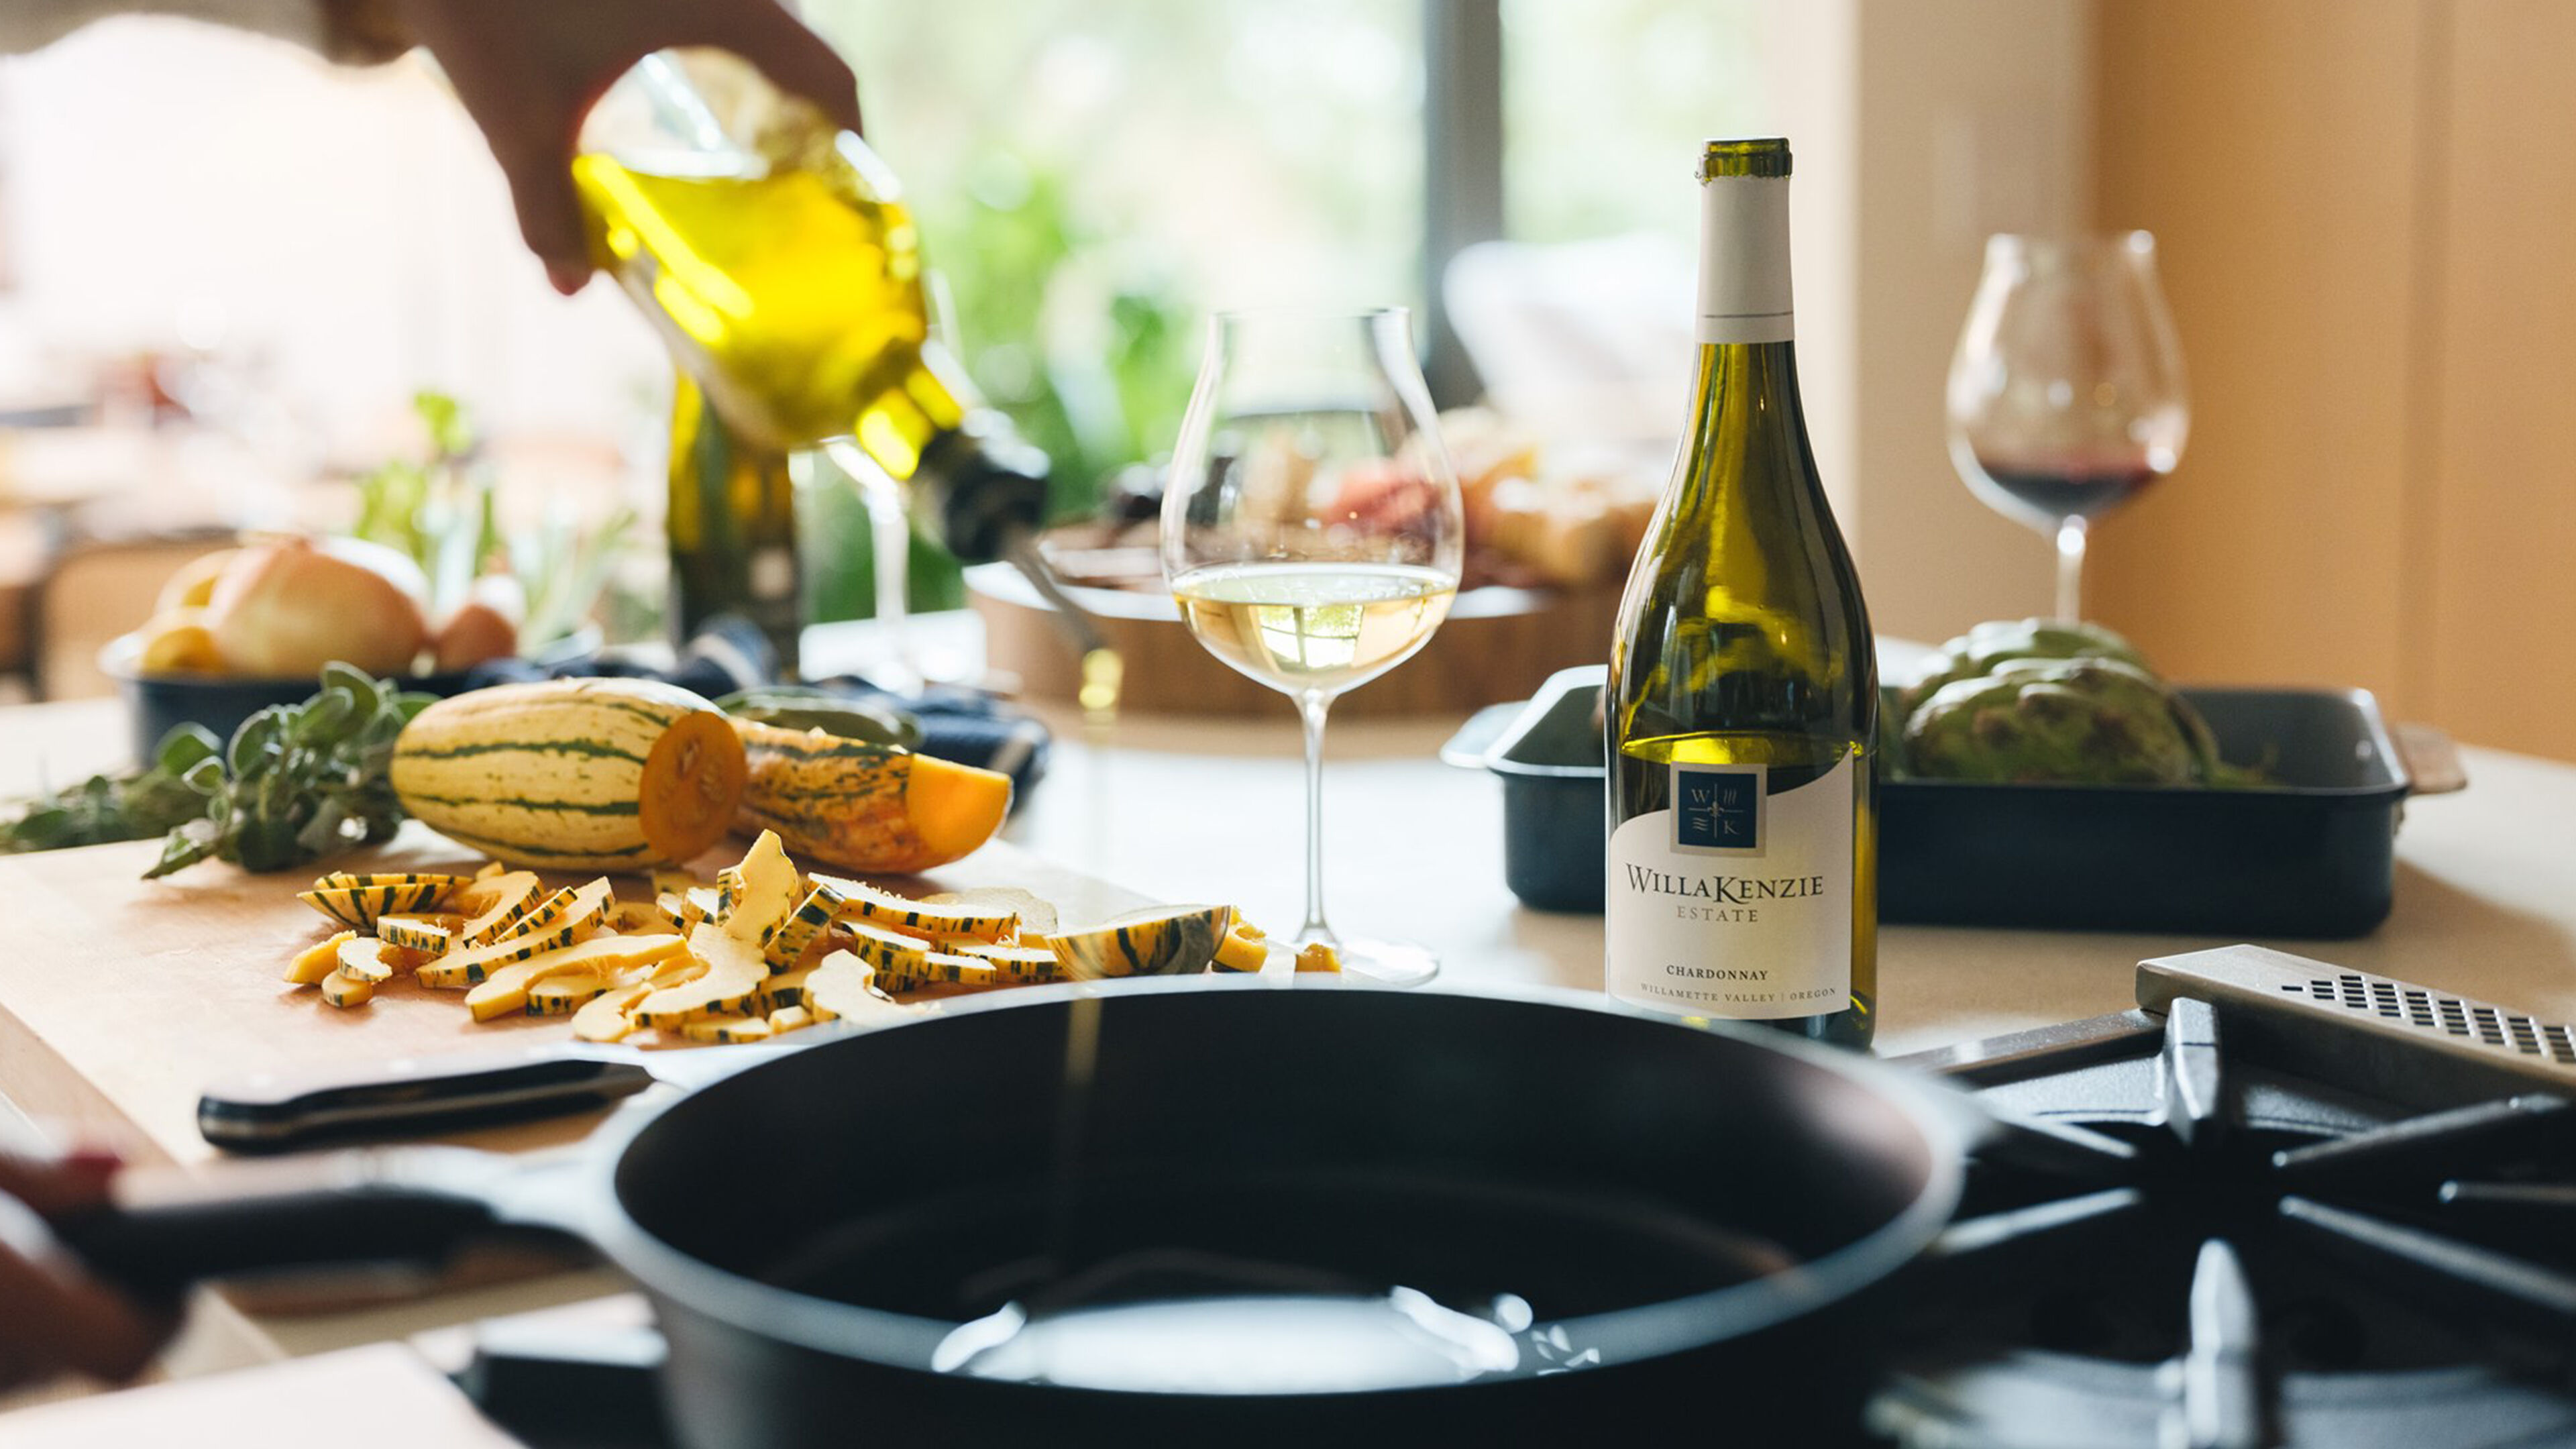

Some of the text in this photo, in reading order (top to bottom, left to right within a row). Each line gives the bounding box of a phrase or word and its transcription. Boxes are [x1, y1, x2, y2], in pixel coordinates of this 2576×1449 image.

[1691, 789, 1709, 802] W
[1724, 820, 1741, 835] K
[1677, 906, 1758, 922] ESTATE
[1666, 965, 1768, 981] CHARDONNAY
[1641, 983, 1836, 1002] WILLAMETTE VALLEY OREGON
